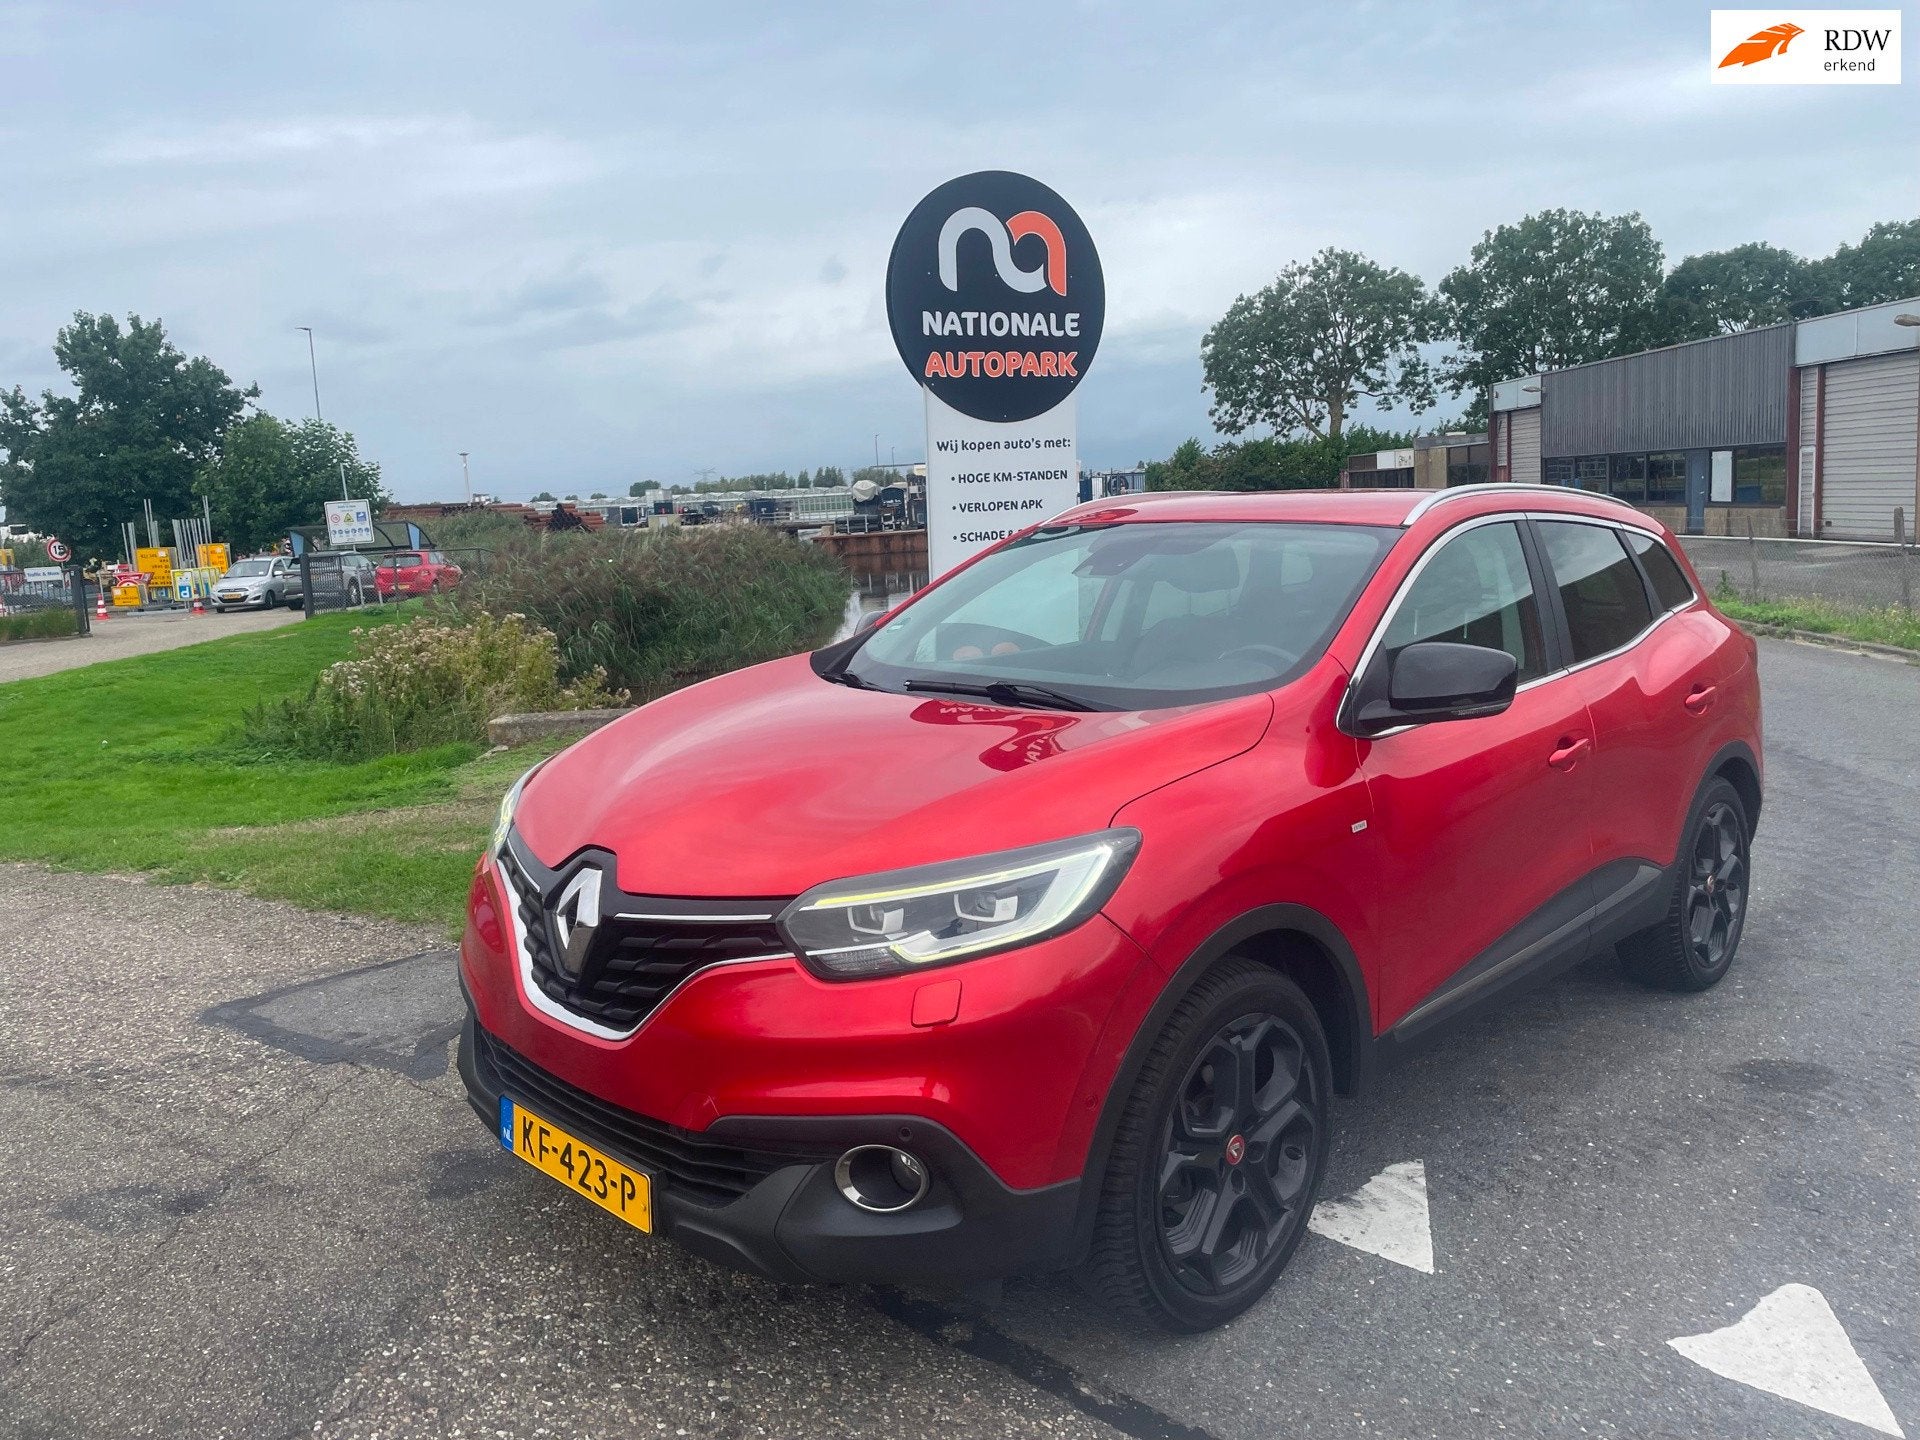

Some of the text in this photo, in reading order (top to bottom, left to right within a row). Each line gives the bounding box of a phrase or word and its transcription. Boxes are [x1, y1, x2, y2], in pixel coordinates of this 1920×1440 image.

[922, 310, 1080, 337] NATIONALE
[924, 351, 1078, 378] AUTOPARK
[936, 438, 1071, 454] Wij kopen auto's met:
[958, 470, 1068, 484] HOGE KM-STANDEN
[959, 499, 1043, 513] VERLOPEN APK
[960, 530, 1005, 542] SCHADE
[53, 545, 65, 555] 15
[522, 1115, 636, 1212] KF-423-P
